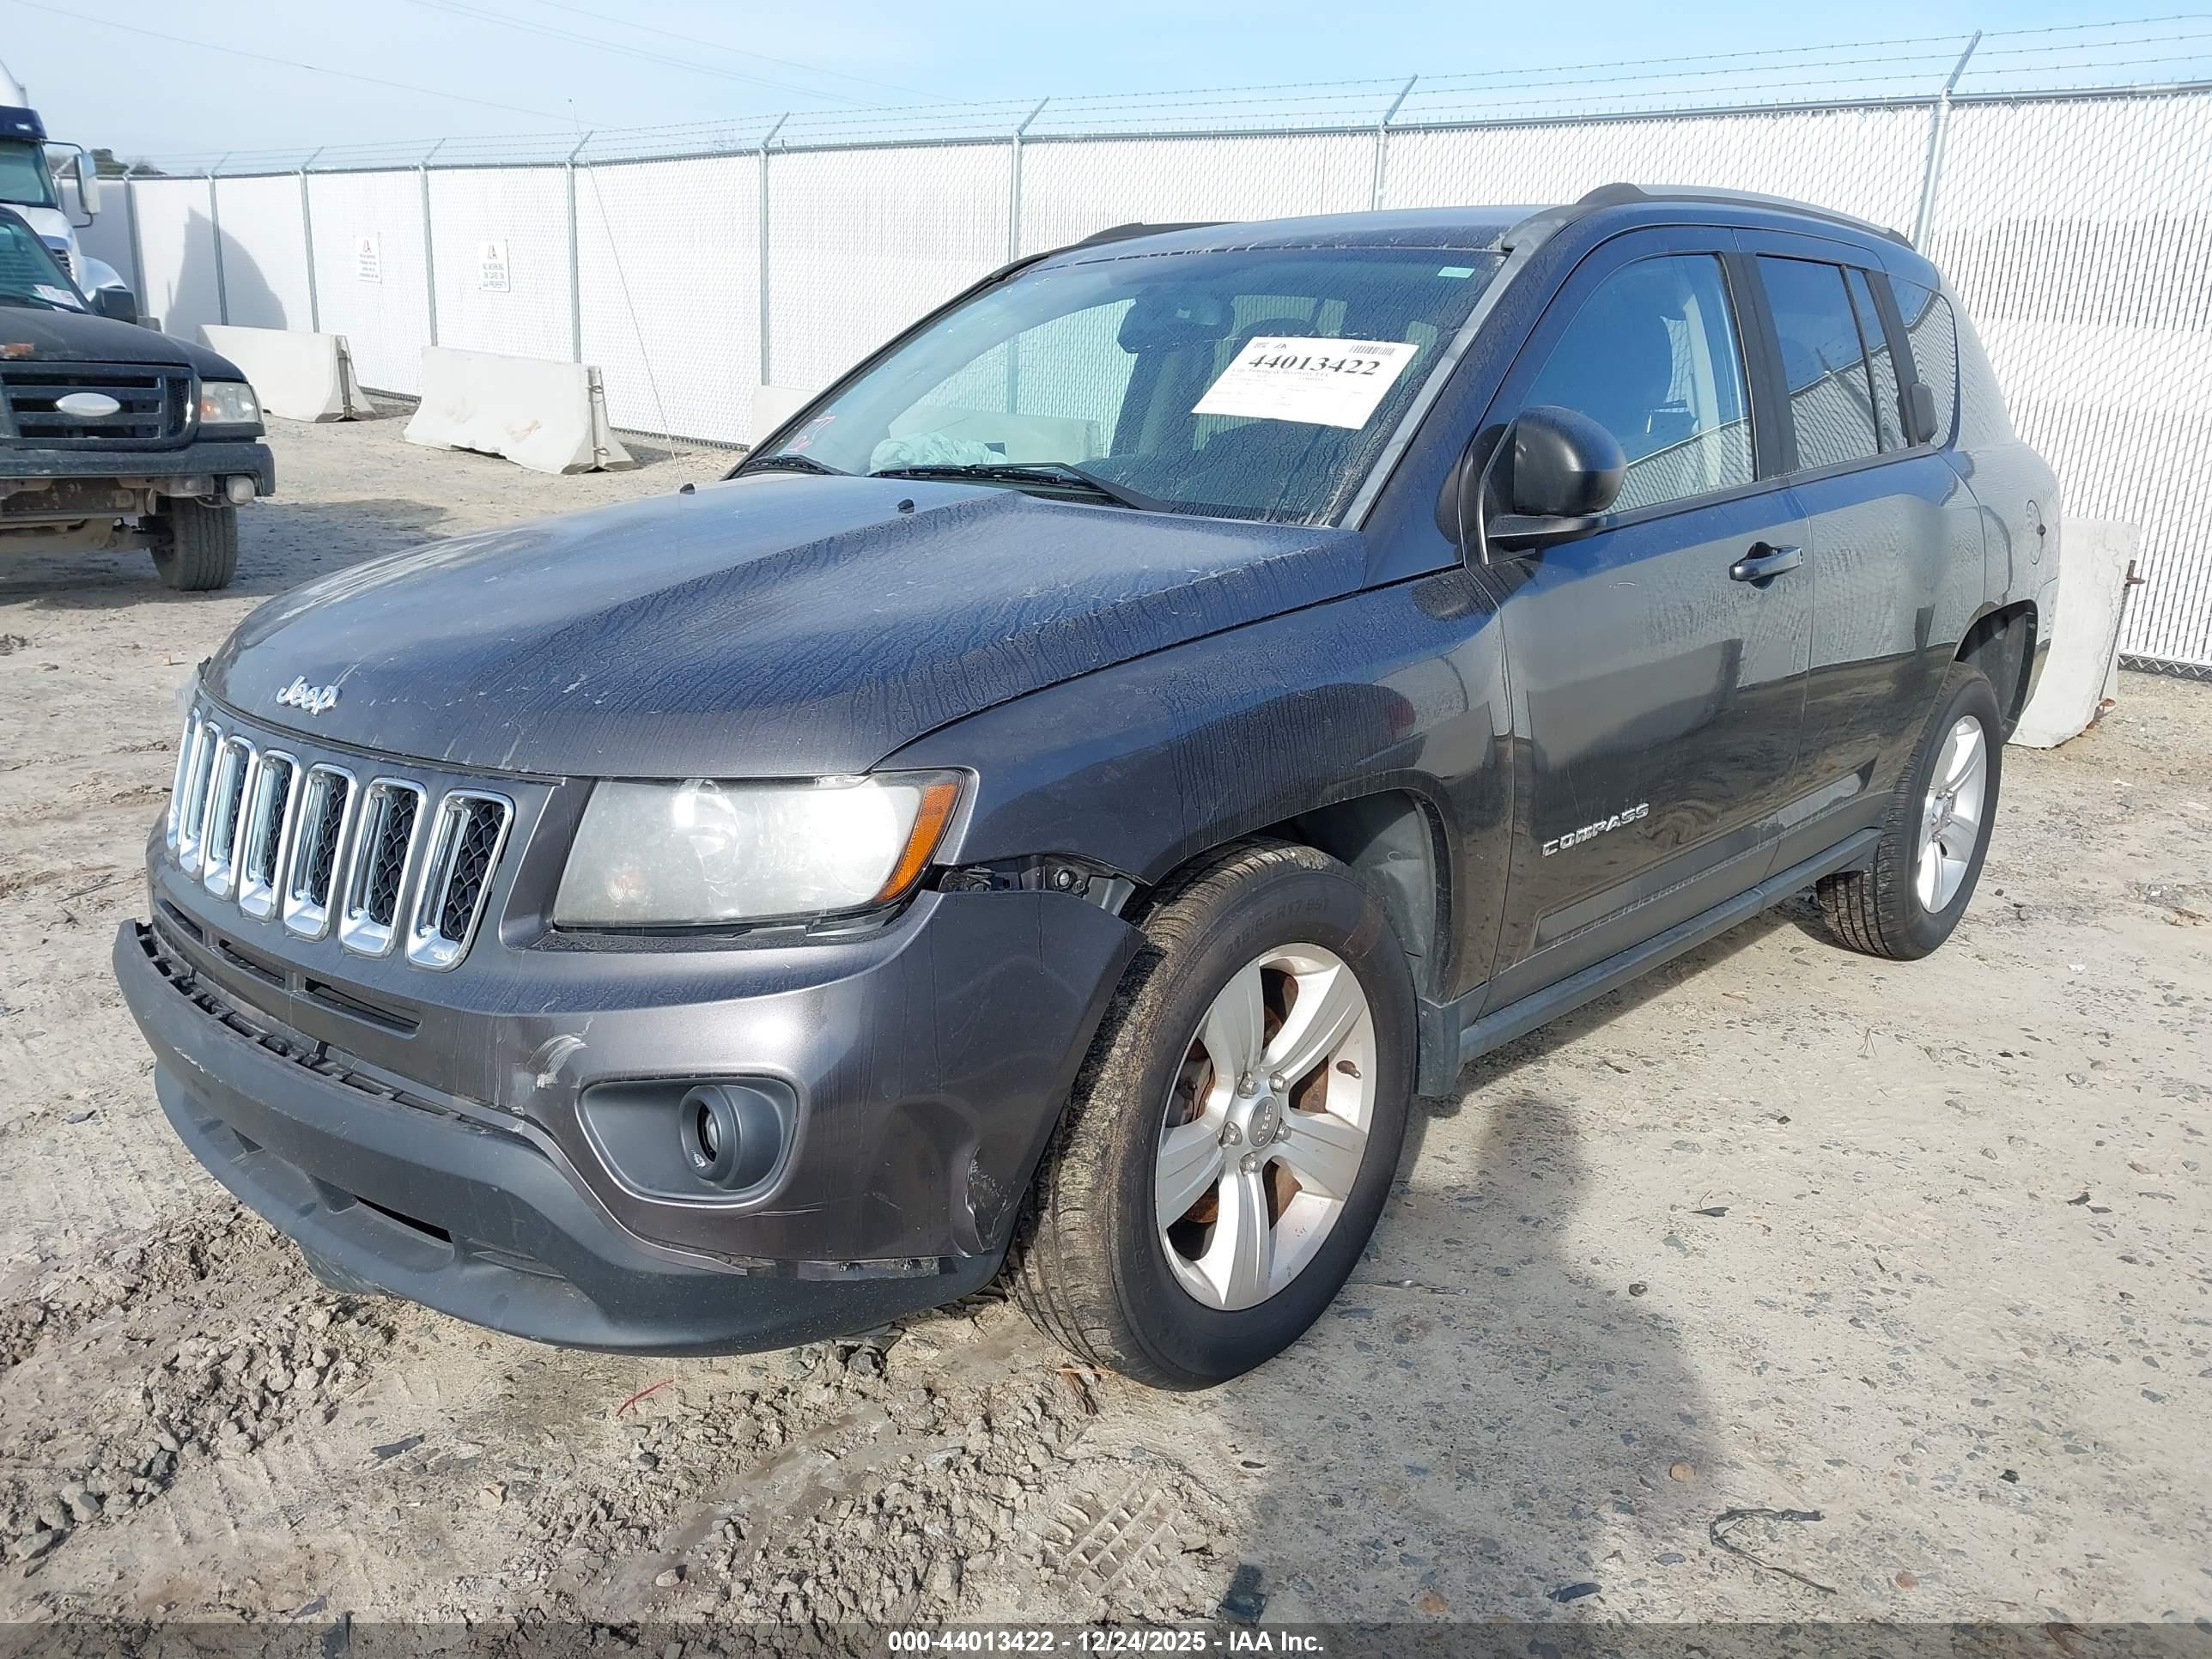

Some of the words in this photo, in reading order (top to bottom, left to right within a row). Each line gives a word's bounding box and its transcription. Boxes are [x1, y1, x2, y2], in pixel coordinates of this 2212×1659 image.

[1249, 354, 1381, 375] 44013422
[276, 675, 340, 715] Jeep
[1541, 802, 1650, 859] COMPASS
